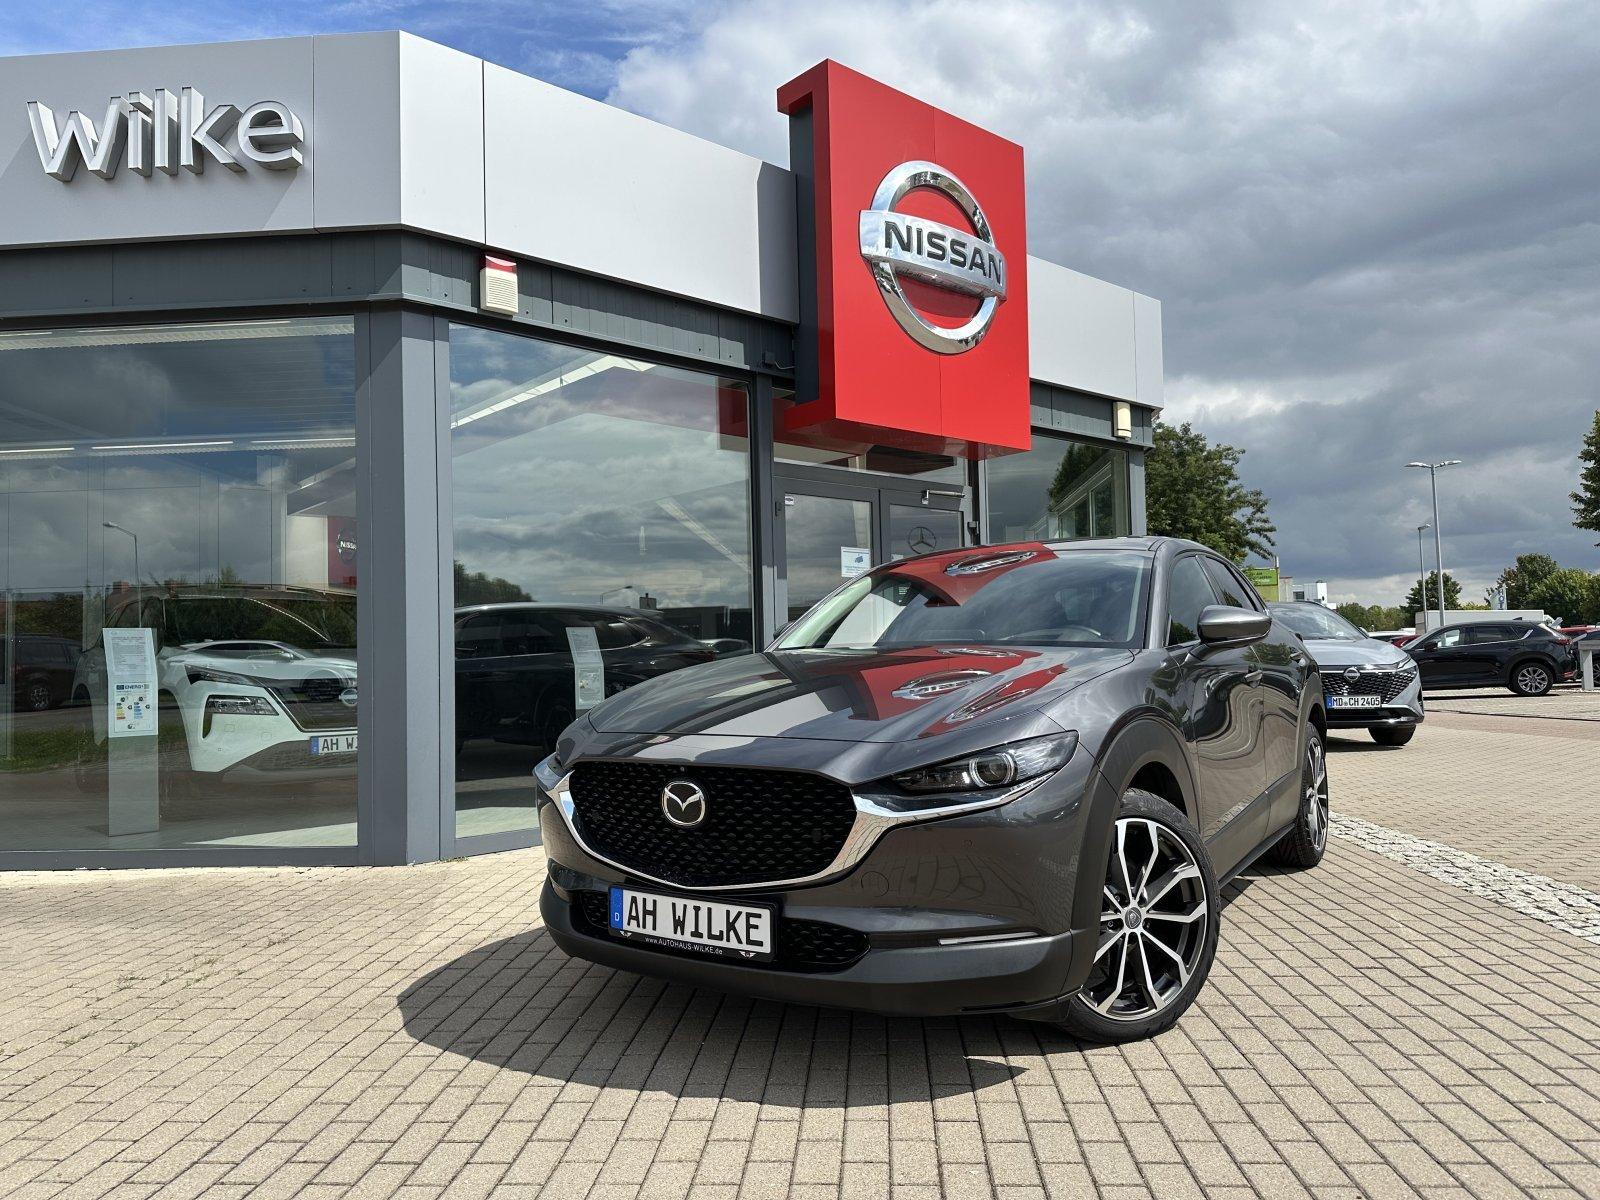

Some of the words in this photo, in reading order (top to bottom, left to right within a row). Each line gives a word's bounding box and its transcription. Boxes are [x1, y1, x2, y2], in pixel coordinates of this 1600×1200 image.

[884, 220, 1004, 285] NISSAN
[340, 540, 357, 550] NISSA
[1332, 697, 1344, 707] MD
[1348, 697, 1360, 707] CH
[1361, 697, 1380, 707] 2405
[322, 738, 339, 751] AH
[345, 736, 358, 750] W
[614, 912, 621, 922] D
[627, 895, 658, 931] AH
[671, 901, 764, 947] WILKE
